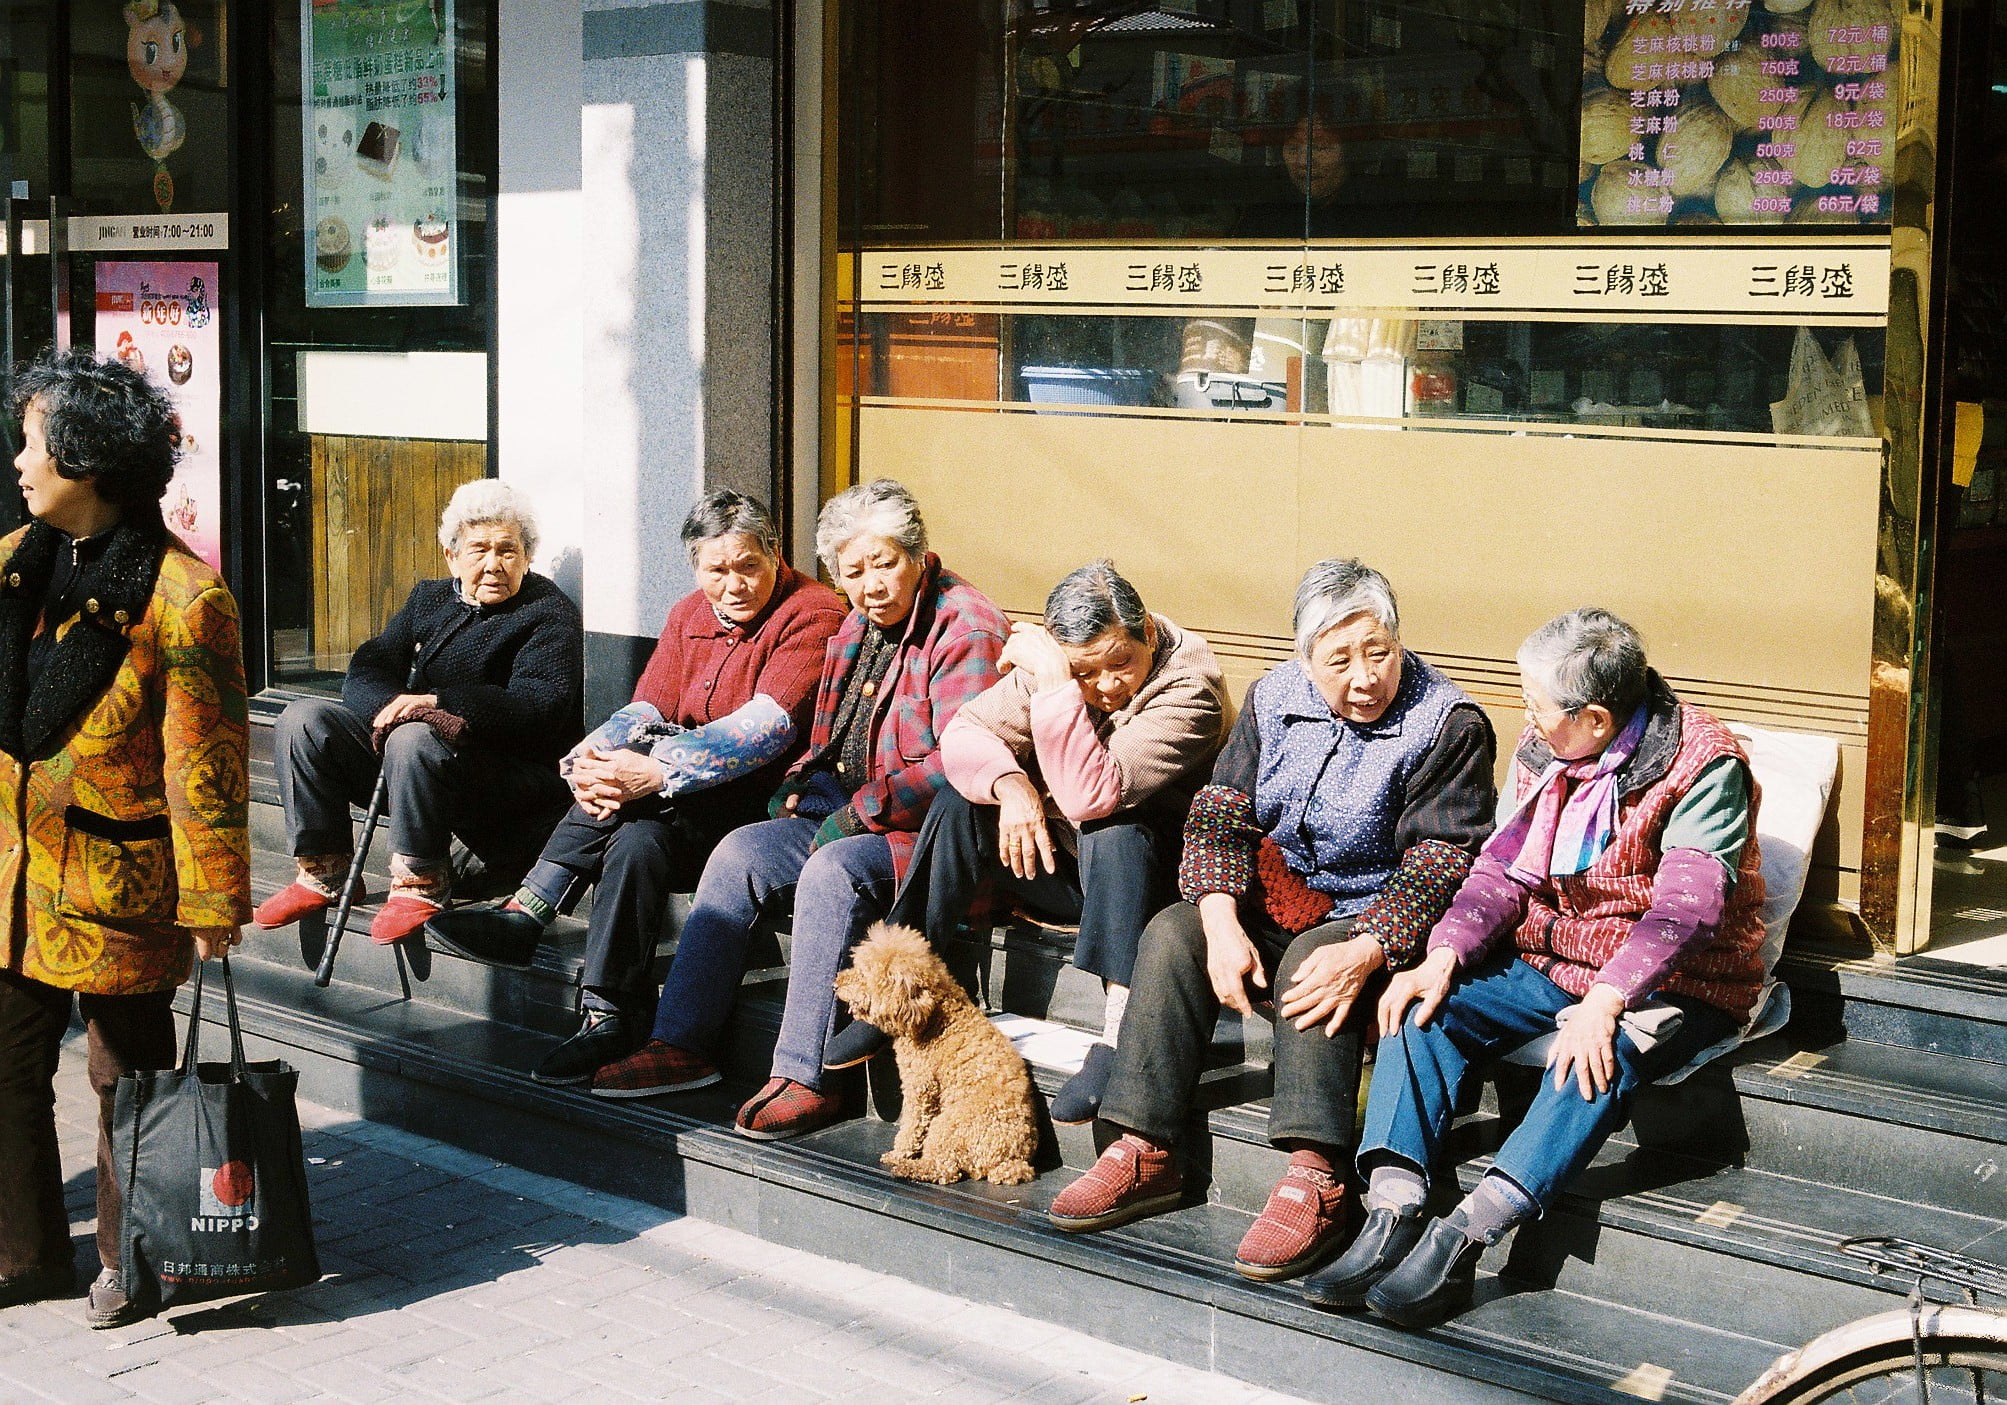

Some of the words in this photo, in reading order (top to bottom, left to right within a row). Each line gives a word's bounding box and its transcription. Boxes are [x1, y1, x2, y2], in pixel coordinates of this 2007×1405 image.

[1632, 34, 1715, 54] 芝麻核桃粉
[1760, 32, 1800, 48] 800克
[1828, 26, 1889, 43] 72元/桶
[1631, 61, 1715, 81] 芝麻核桃粉
[1760, 60, 1799, 75] 750克
[1826, 54, 1887, 72] 72元/桶
[1630, 88, 1680, 108] 芝麻粉
[1759, 87, 1798, 103] 250克
[1834, 82, 1886, 101] 9元/袋
[1629, 115, 1678, 134] 芝麻粉
[1758, 115, 1796, 130] 500克
[1825, 110, 1884, 128] 18元/袋
[1756, 142, 1795, 158] 500克
[1846, 140, 1881, 156] 62元
[1628, 169, 1676, 187] 冰糖粉
[1755, 170, 1793, 185] 250克
[1830, 166, 1880, 185] 6元/袋
[1627, 195, 1674, 213] 桃仁粉
[1753, 196, 1791, 212] 500克
[1818, 195, 1879, 213] 66元/袋
[191, 1215, 259, 1233] NIPPO
